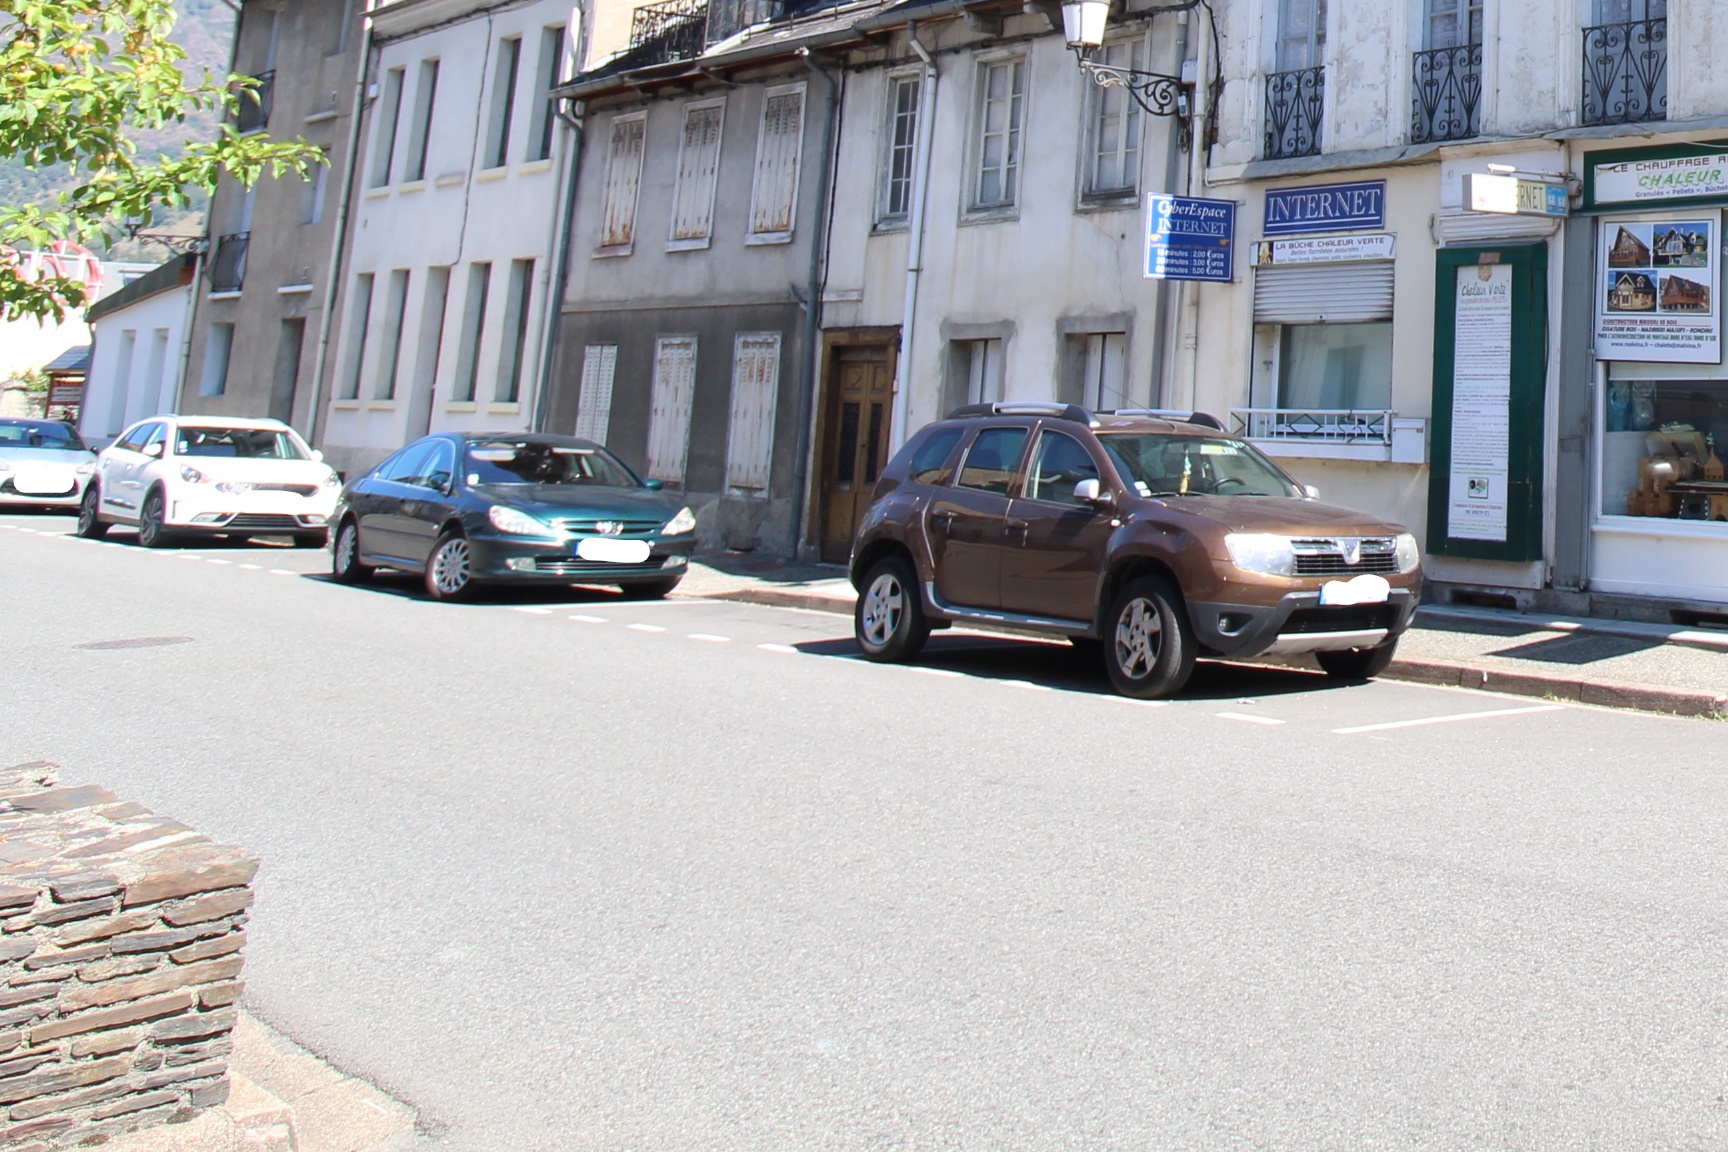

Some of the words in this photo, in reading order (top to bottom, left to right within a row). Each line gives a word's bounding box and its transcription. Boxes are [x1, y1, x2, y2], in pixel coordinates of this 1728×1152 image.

[1636, 157, 1709, 171] CHAUFFAGE
[1638, 169, 1722, 188] CHALEUR
[1635, 190, 1664, 198] Granulés
[1158, 200, 1226, 220] CyberEspace
[1267, 189, 1380, 221] INTERNET
[1158, 218, 1226, 234] INTERNET
[1288, 240, 1314, 249] BÛCHE
[1318, 238, 1353, 248] CHALEUR
[1357, 237, 1385, 245] VERTE
[1165, 249, 1188, 257] minutes
[1165, 266, 1188, 274] minutes
